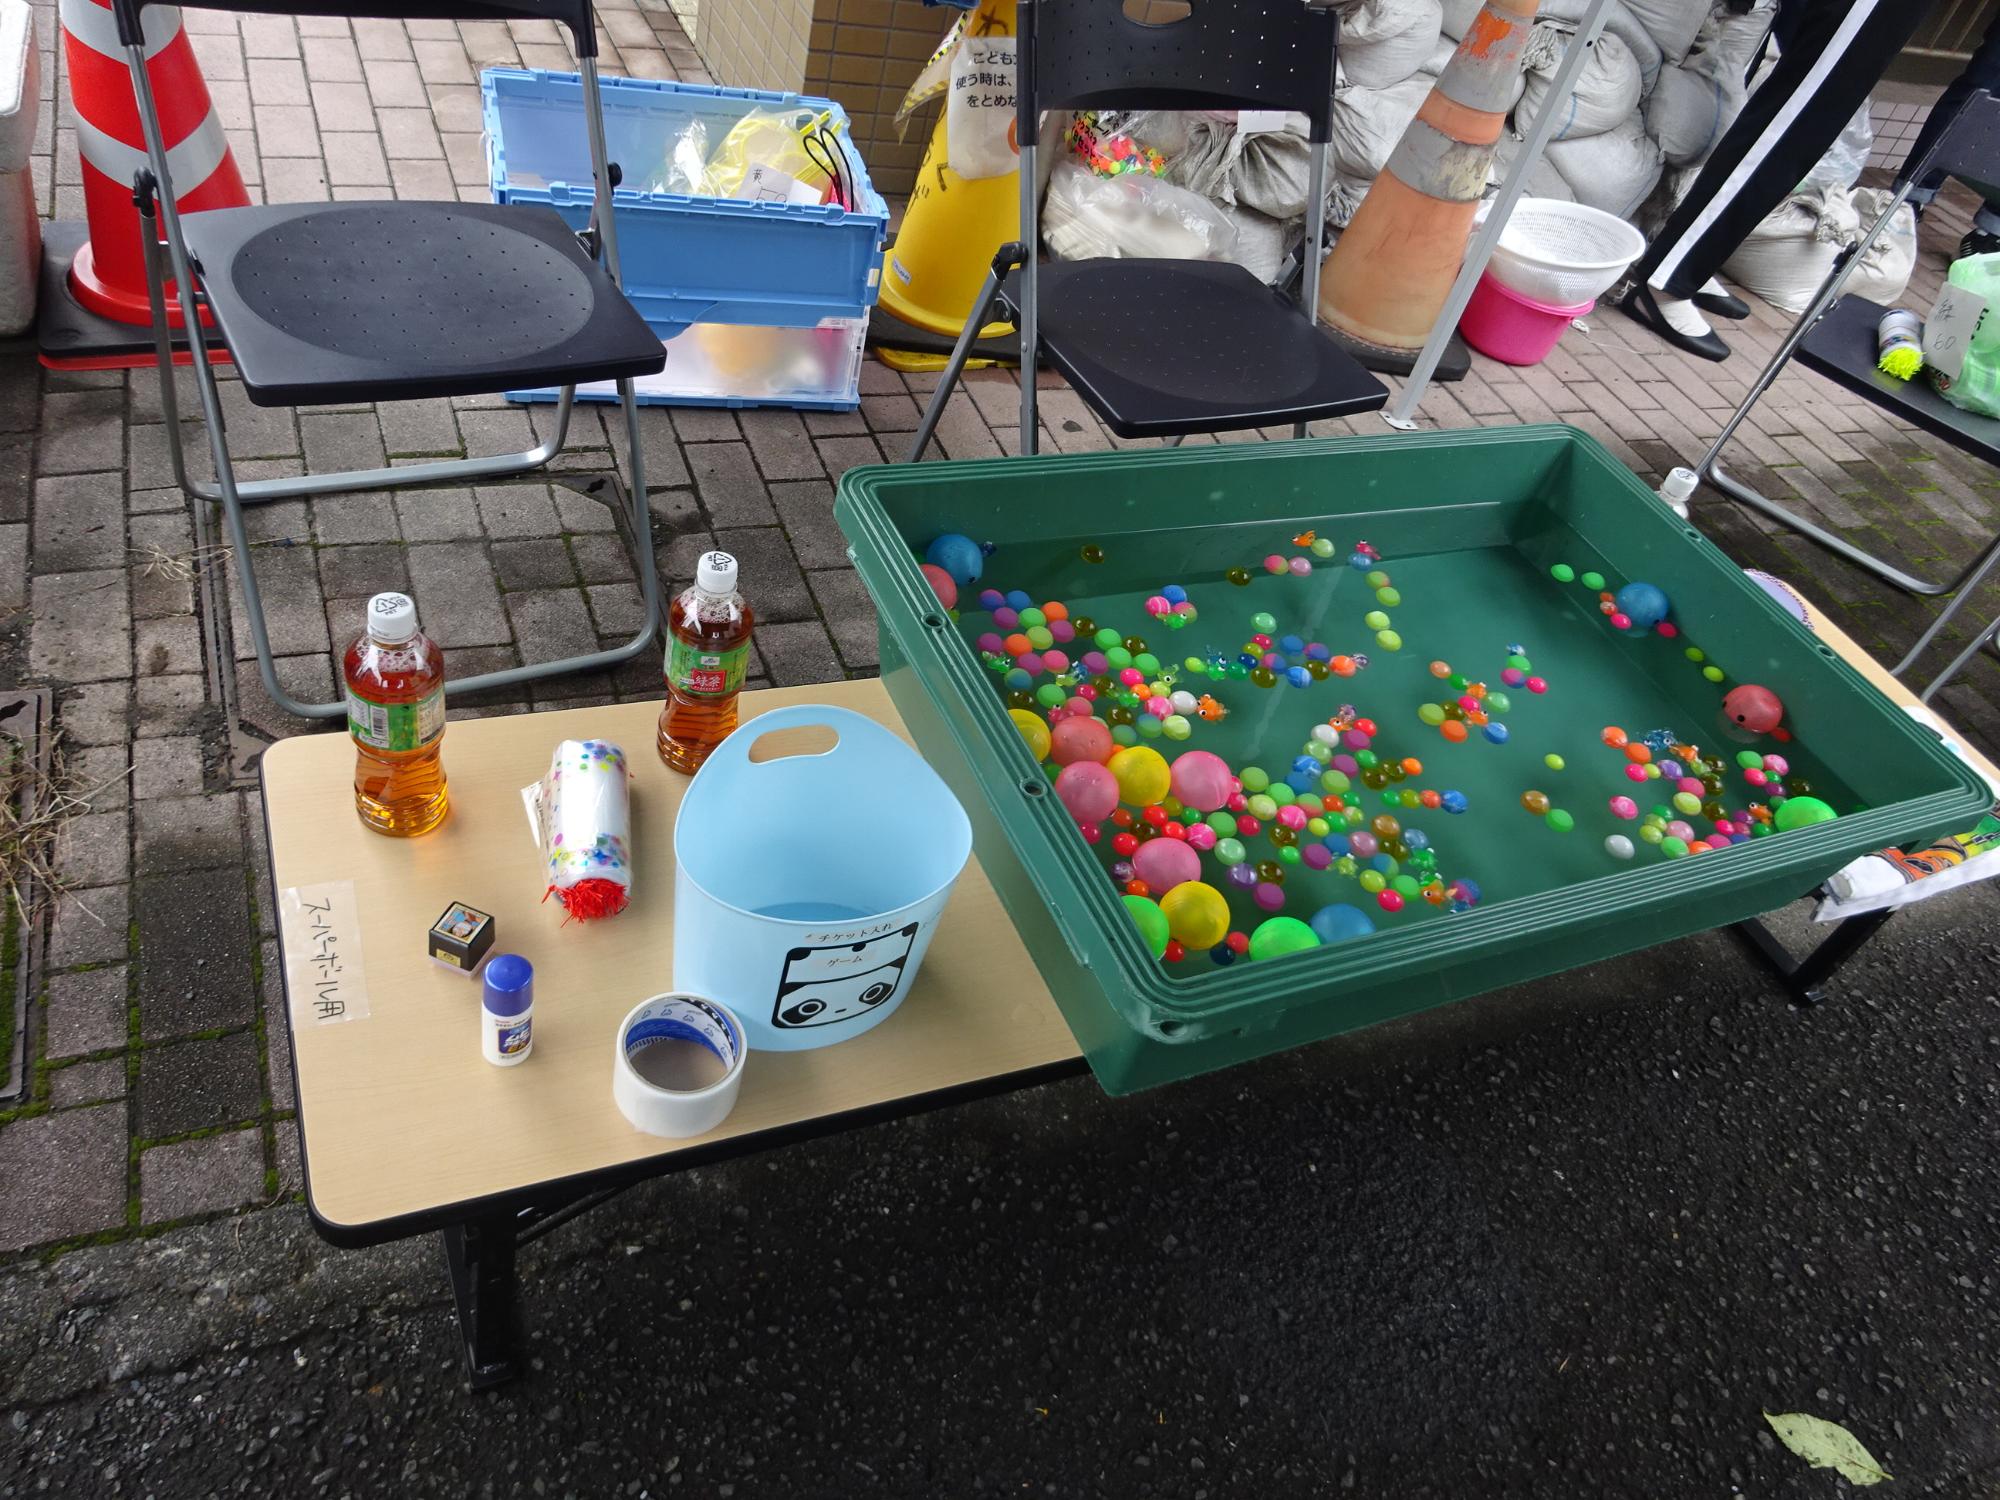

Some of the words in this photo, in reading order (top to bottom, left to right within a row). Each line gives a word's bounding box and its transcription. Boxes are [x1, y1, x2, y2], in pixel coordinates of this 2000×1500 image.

[302, 898, 345, 1020] スーパーボール用
